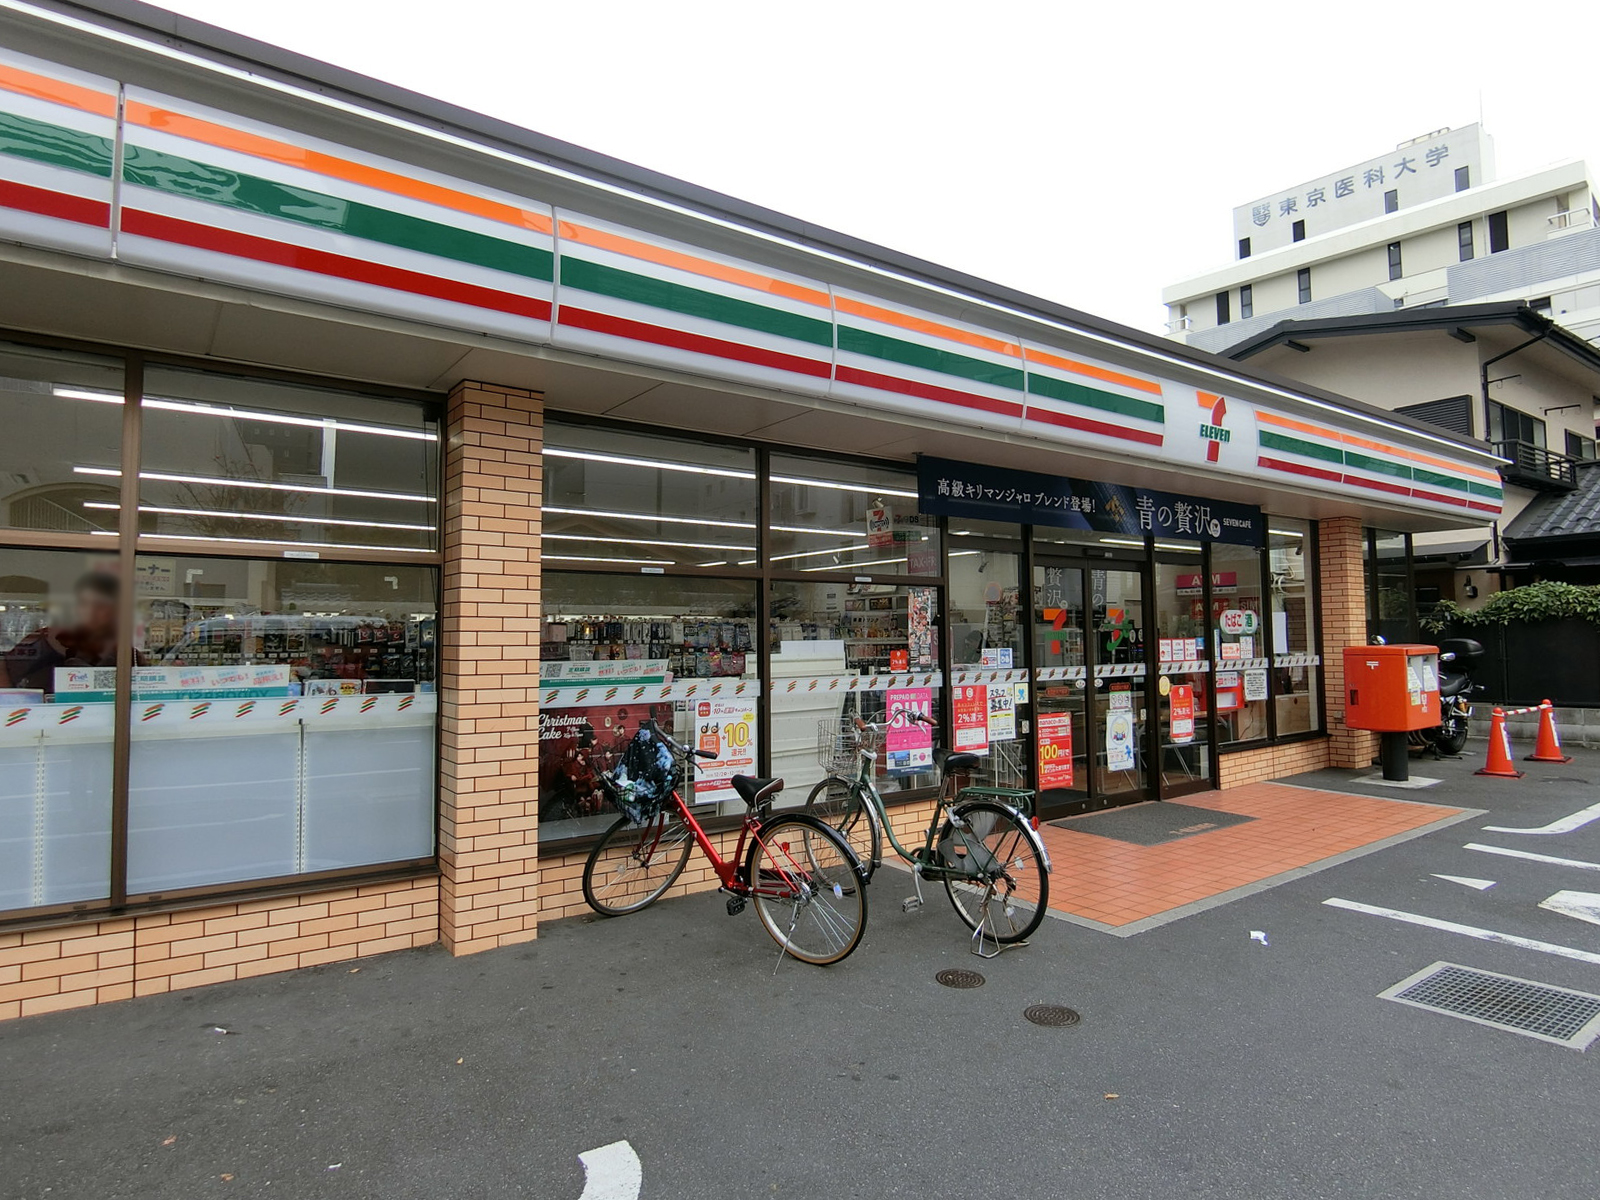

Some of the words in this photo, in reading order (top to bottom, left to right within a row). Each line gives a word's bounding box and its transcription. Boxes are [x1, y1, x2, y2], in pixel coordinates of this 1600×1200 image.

[1278, 143, 1450, 218] 東京医科大学
[1224, 613, 1243, 628] たばこ
[889, 692, 910, 701] PREPAID
[538, 713, 588, 727] Christmas
[890, 700, 929, 729] SIM
[538, 726, 563, 741] Cake
